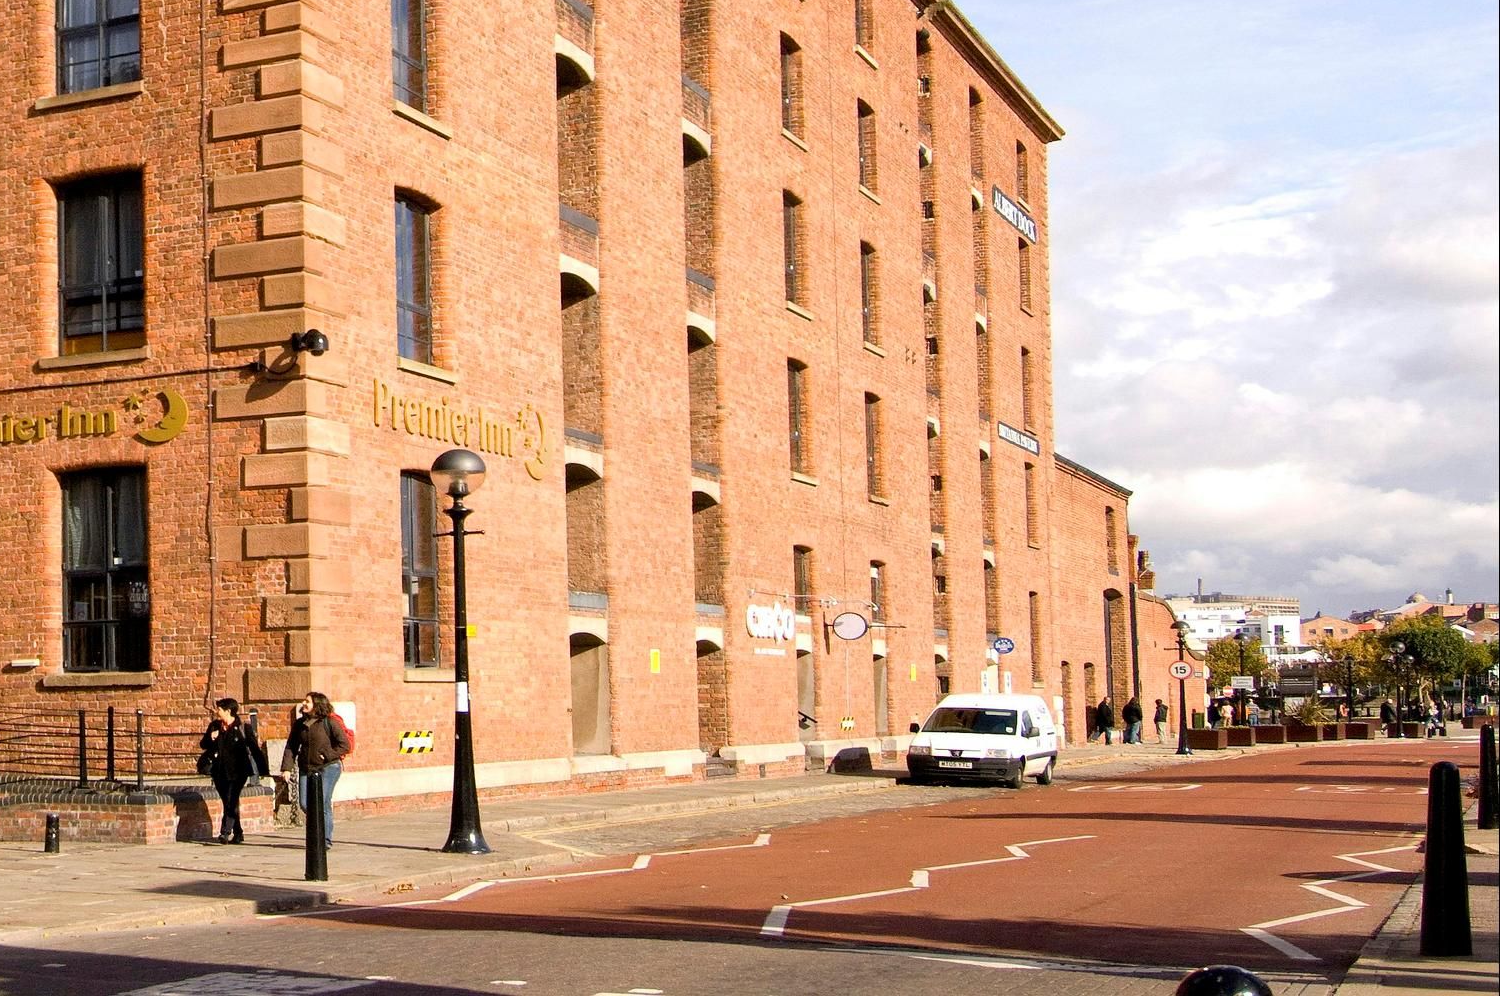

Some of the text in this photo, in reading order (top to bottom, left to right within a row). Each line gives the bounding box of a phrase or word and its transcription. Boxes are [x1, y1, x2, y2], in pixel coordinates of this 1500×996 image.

[58, 404, 117, 439] Inn
[373, 378, 513, 458] Premier Inn
[1174, 666, 1186, 674] 15
